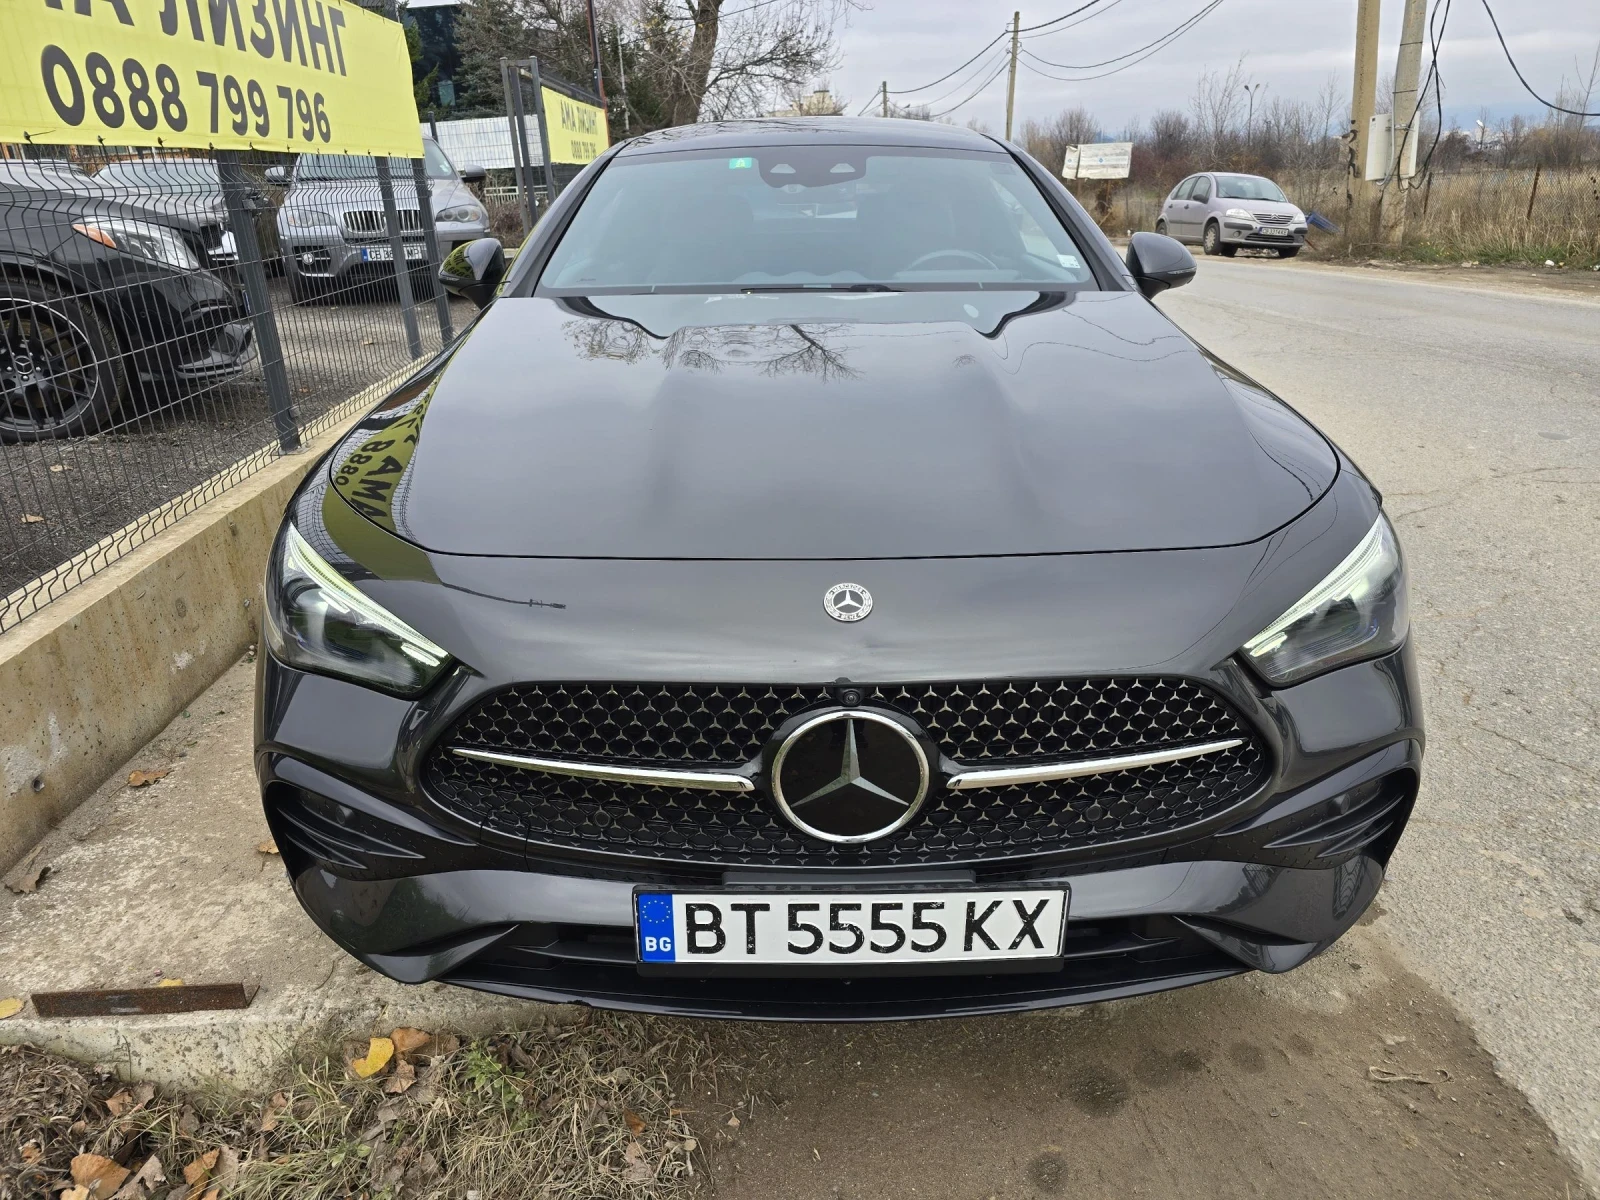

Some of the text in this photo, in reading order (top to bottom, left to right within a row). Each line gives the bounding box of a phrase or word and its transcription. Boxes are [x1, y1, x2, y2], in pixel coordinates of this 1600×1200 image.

[41, 44, 331, 143] 0888 799 796
[645, 936, 672, 953] BG
[685, 898, 1050, 955] BT 5555 KX
